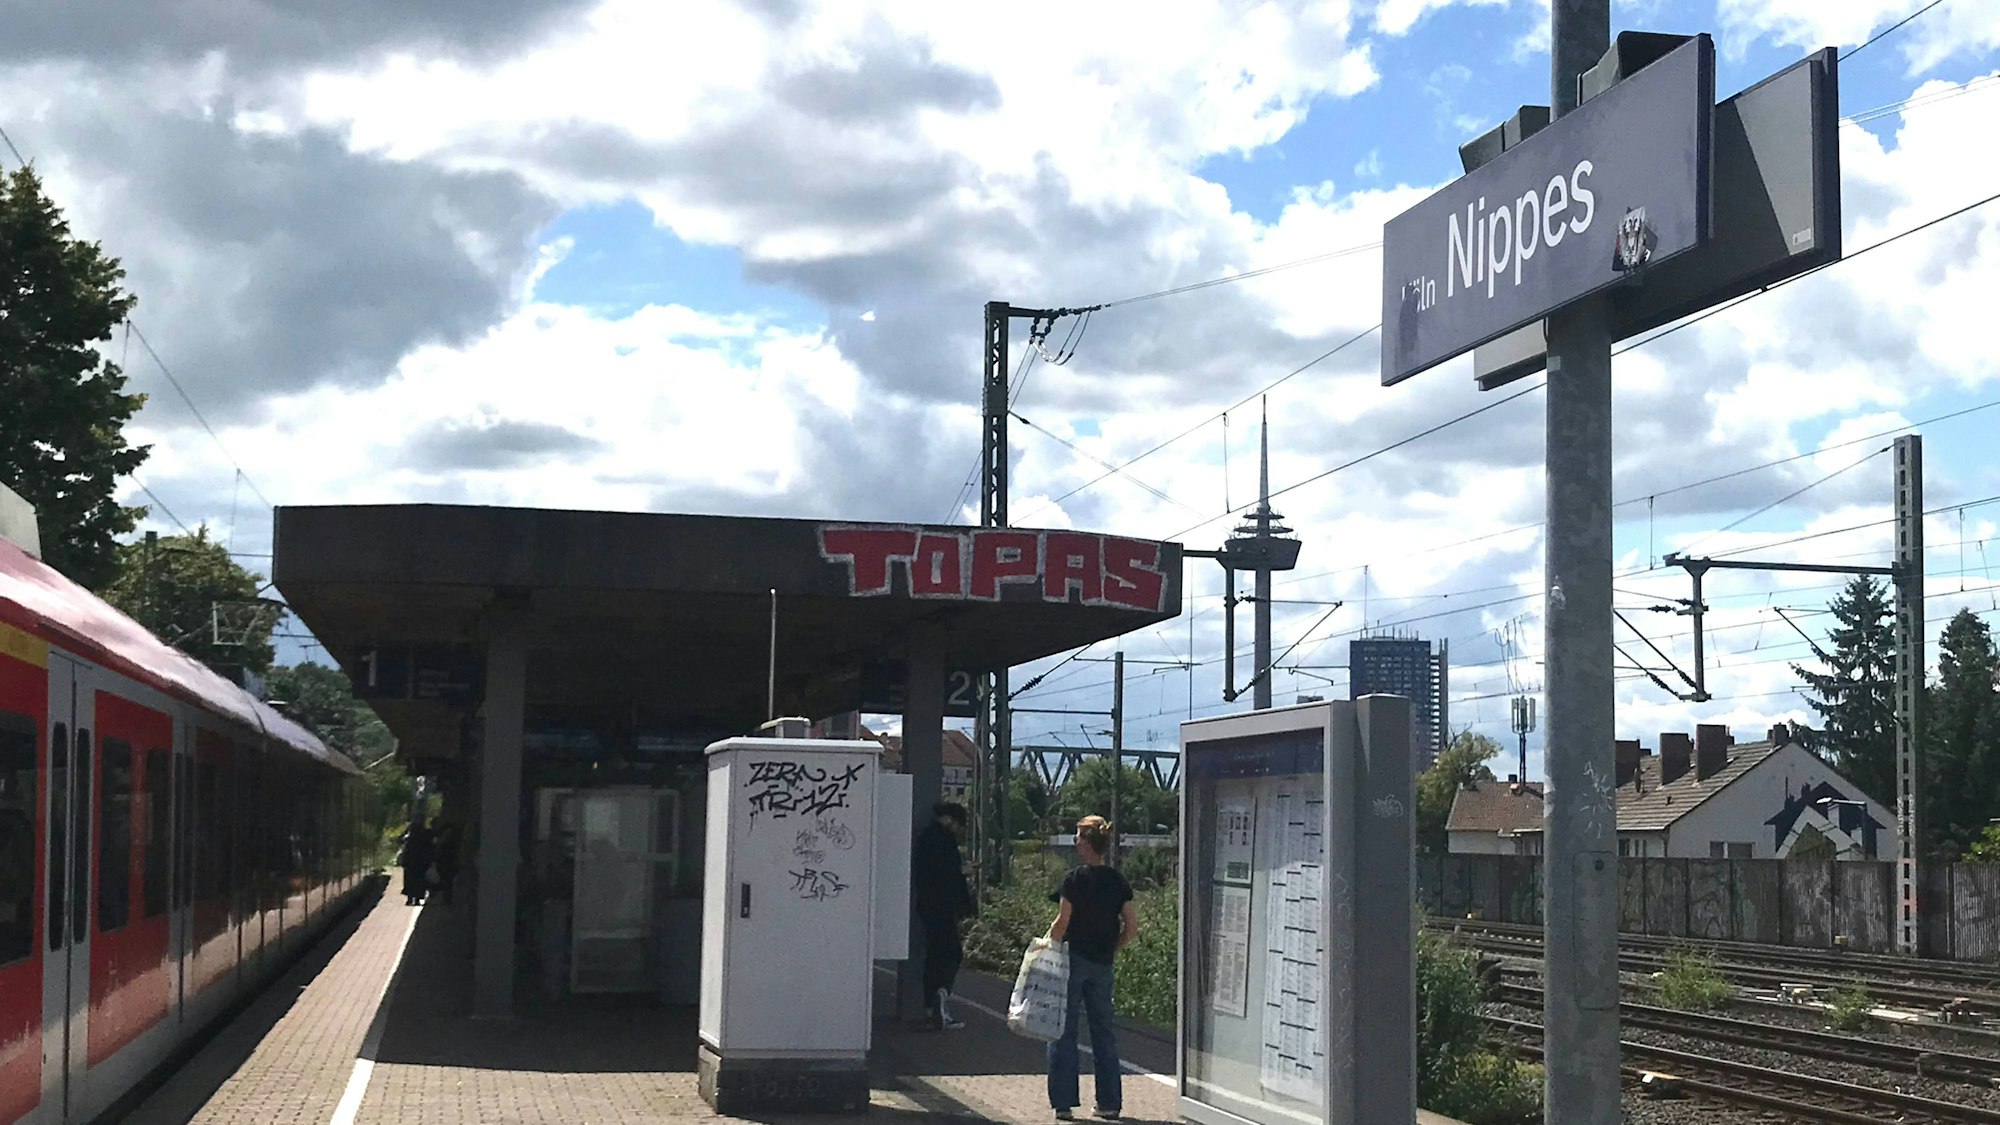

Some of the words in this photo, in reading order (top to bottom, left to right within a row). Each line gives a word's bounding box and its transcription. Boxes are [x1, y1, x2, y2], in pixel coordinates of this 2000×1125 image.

[1448, 160, 1595, 298] Nippes
[819, 524, 1167, 612] TOPAS
[361, 650, 377, 687] 1
[948, 670, 971, 706] 2
